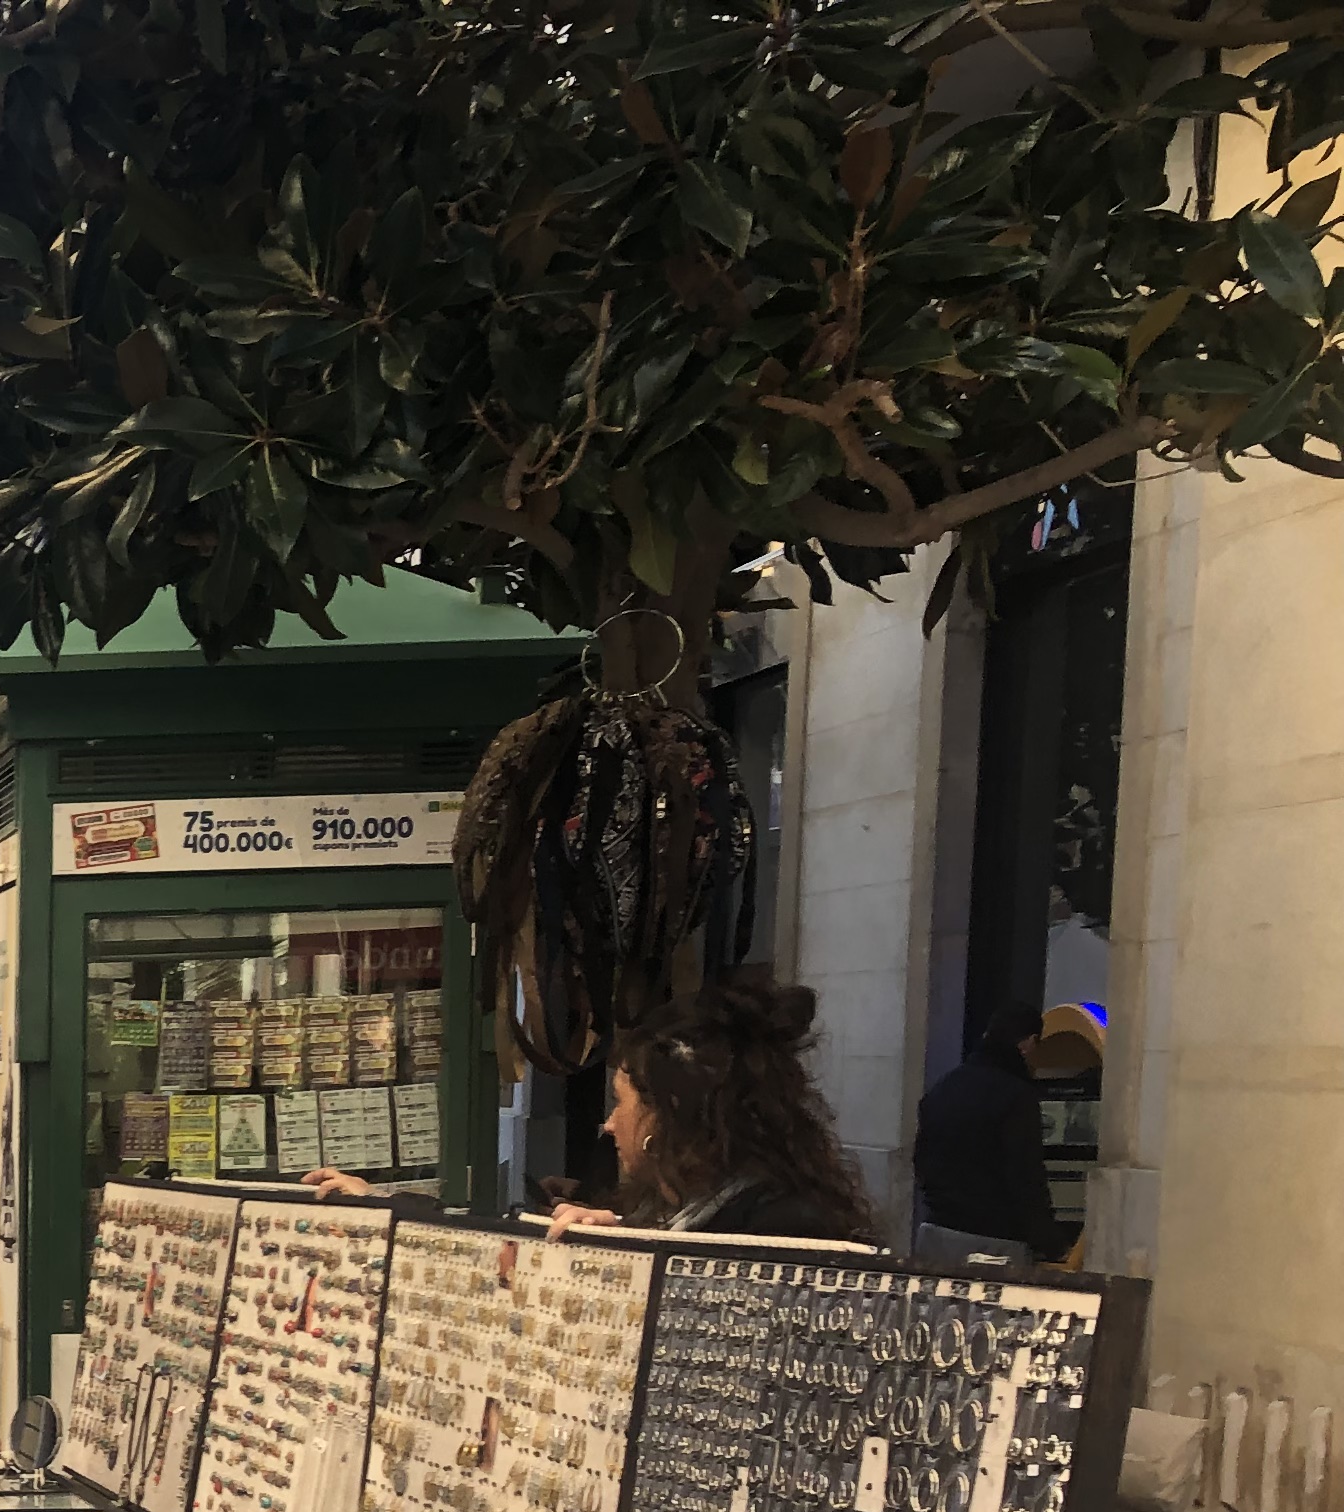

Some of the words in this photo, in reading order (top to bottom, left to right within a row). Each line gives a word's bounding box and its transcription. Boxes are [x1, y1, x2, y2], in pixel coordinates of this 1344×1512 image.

[337, 806, 349, 815] de
[183, 811, 214, 832] 75
[217, 816, 257, 830] premis
[260, 816, 275, 826] de
[313, 816, 413, 840] 910.000
[183, 831, 293, 853] 400.000€
